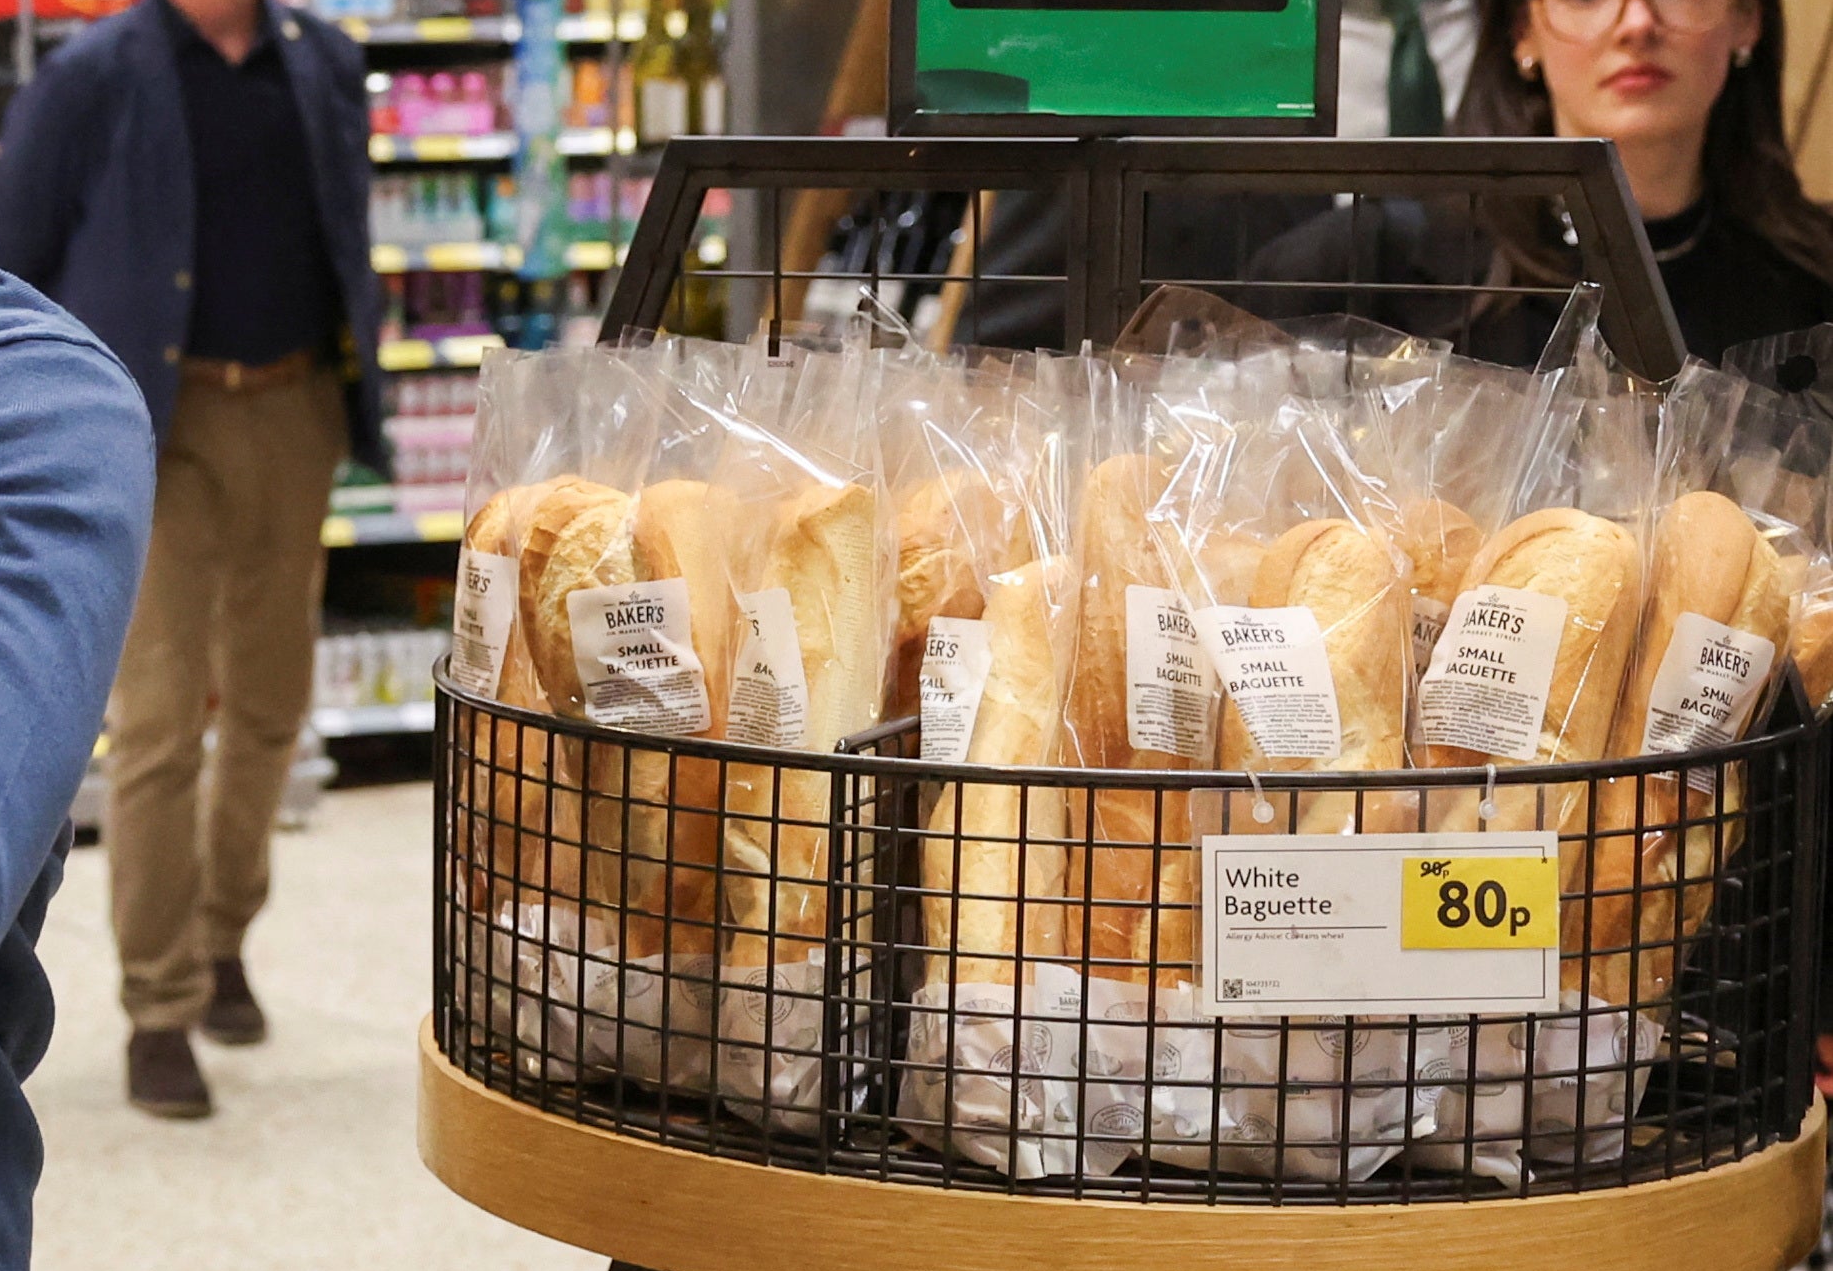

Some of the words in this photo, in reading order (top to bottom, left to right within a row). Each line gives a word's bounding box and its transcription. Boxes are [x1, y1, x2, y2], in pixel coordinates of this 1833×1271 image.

[605, 605, 665, 630] BAKER'S
[1157, 612, 1198, 640] BAKER'S
[1221, 628, 1286, 647] BAKER'S
[617, 642, 664, 658] SMALL
[1457, 646, 1506, 665] SMALL
[606, 654, 680, 675] BAGUETTE
[1165, 651, 1195, 670] SMALL
[1240, 660, 1289, 675] SMALL
[1699, 646, 1751, 678] BAKER'S
[1156, 668, 1203, 688] BAGUETTE
[1229, 675, 1306, 694] BAGUETTE
[1225, 866, 1300, 889] White
[1224, 895, 1333, 922] Baguette
[1436, 879, 1531, 937] 80p
[1225, 932, 1252, 942] Allergy
[1320, 932, 1345, 940] wheat
